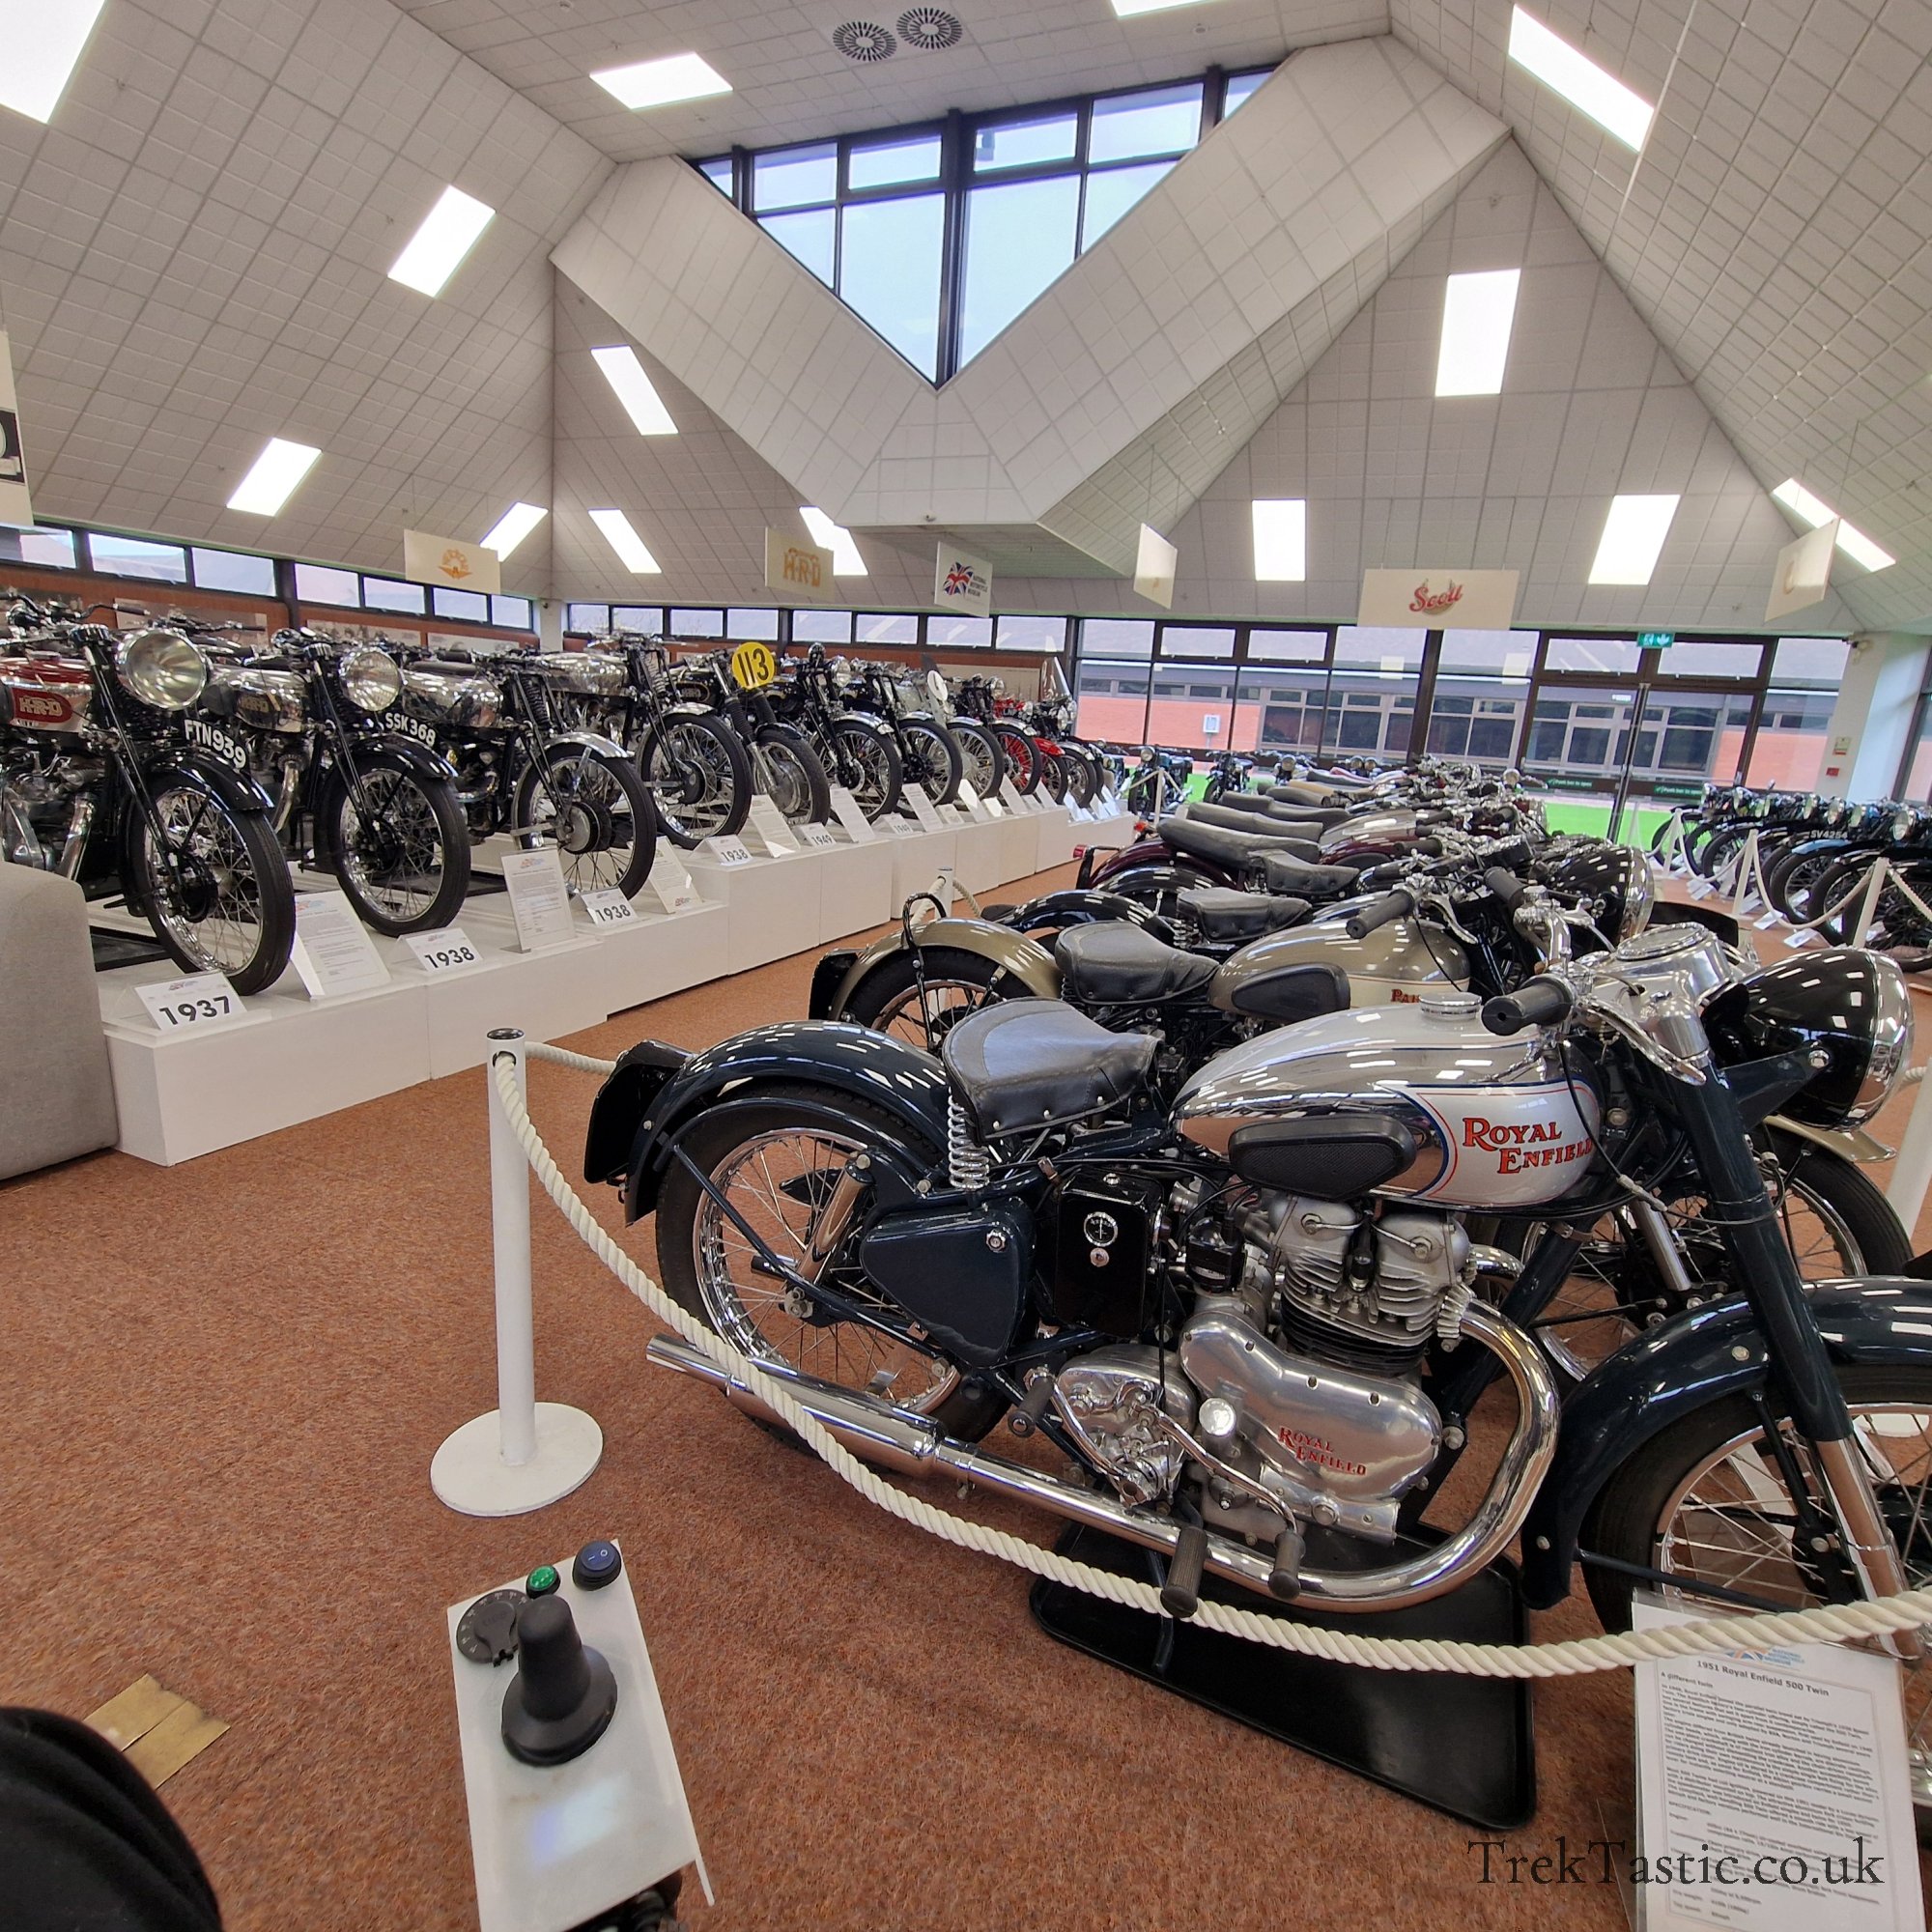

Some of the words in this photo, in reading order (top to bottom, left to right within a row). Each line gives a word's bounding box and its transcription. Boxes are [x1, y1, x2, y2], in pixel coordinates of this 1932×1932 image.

[737, 648, 769, 687] 113
[721, 848, 750, 863] 1938
[595, 904, 632, 922] 1938
[424, 947, 475, 969] 1938
[158, 995, 231, 1026] 1937
[1462, 1118, 1563, 1152] ROYAL
[1278, 1426, 1335, 1452] ROYAL
[1294, 1444, 1367, 1476] ENFIELD
[1697, 1660, 1720, 1672] 1951
[1721, 1664, 1748, 1679] Royal
[1750, 1672, 1784, 1687] Enfield
[1785, 1680, 1804, 1691] 500
[1805, 1684, 1831, 1697] Twin
